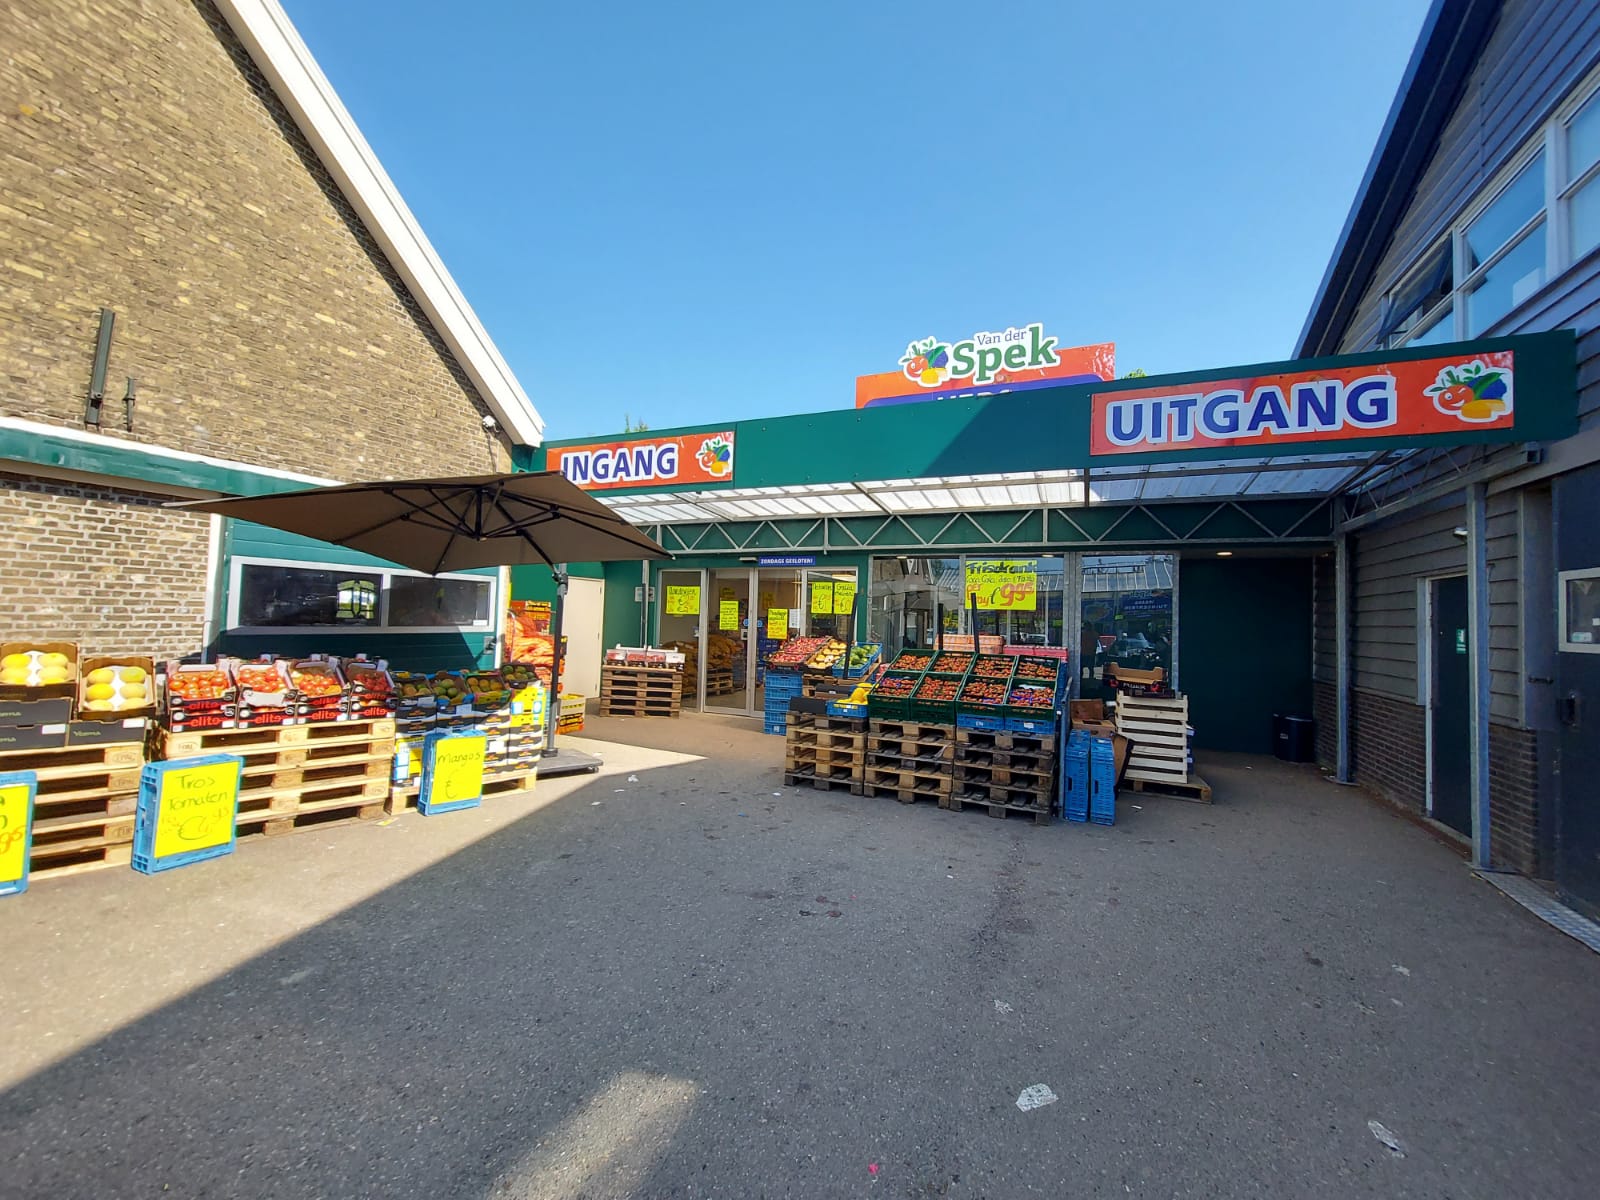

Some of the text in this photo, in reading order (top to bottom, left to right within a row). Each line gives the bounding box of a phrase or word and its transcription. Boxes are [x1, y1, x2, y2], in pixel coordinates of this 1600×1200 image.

[976, 330, 1027, 346] Van der
[951, 326, 1057, 382] Spek
[1112, 380, 1388, 441] UITGANG
[563, 447, 676, 482] INGANG
[255, 713, 282, 725] elite
[312, 709, 337, 720] elite
[364, 707, 387, 717] elite
[190, 715, 221, 728] elite
[437, 752, 481, 767] Mangos
[176, 774, 216, 789] Tros
